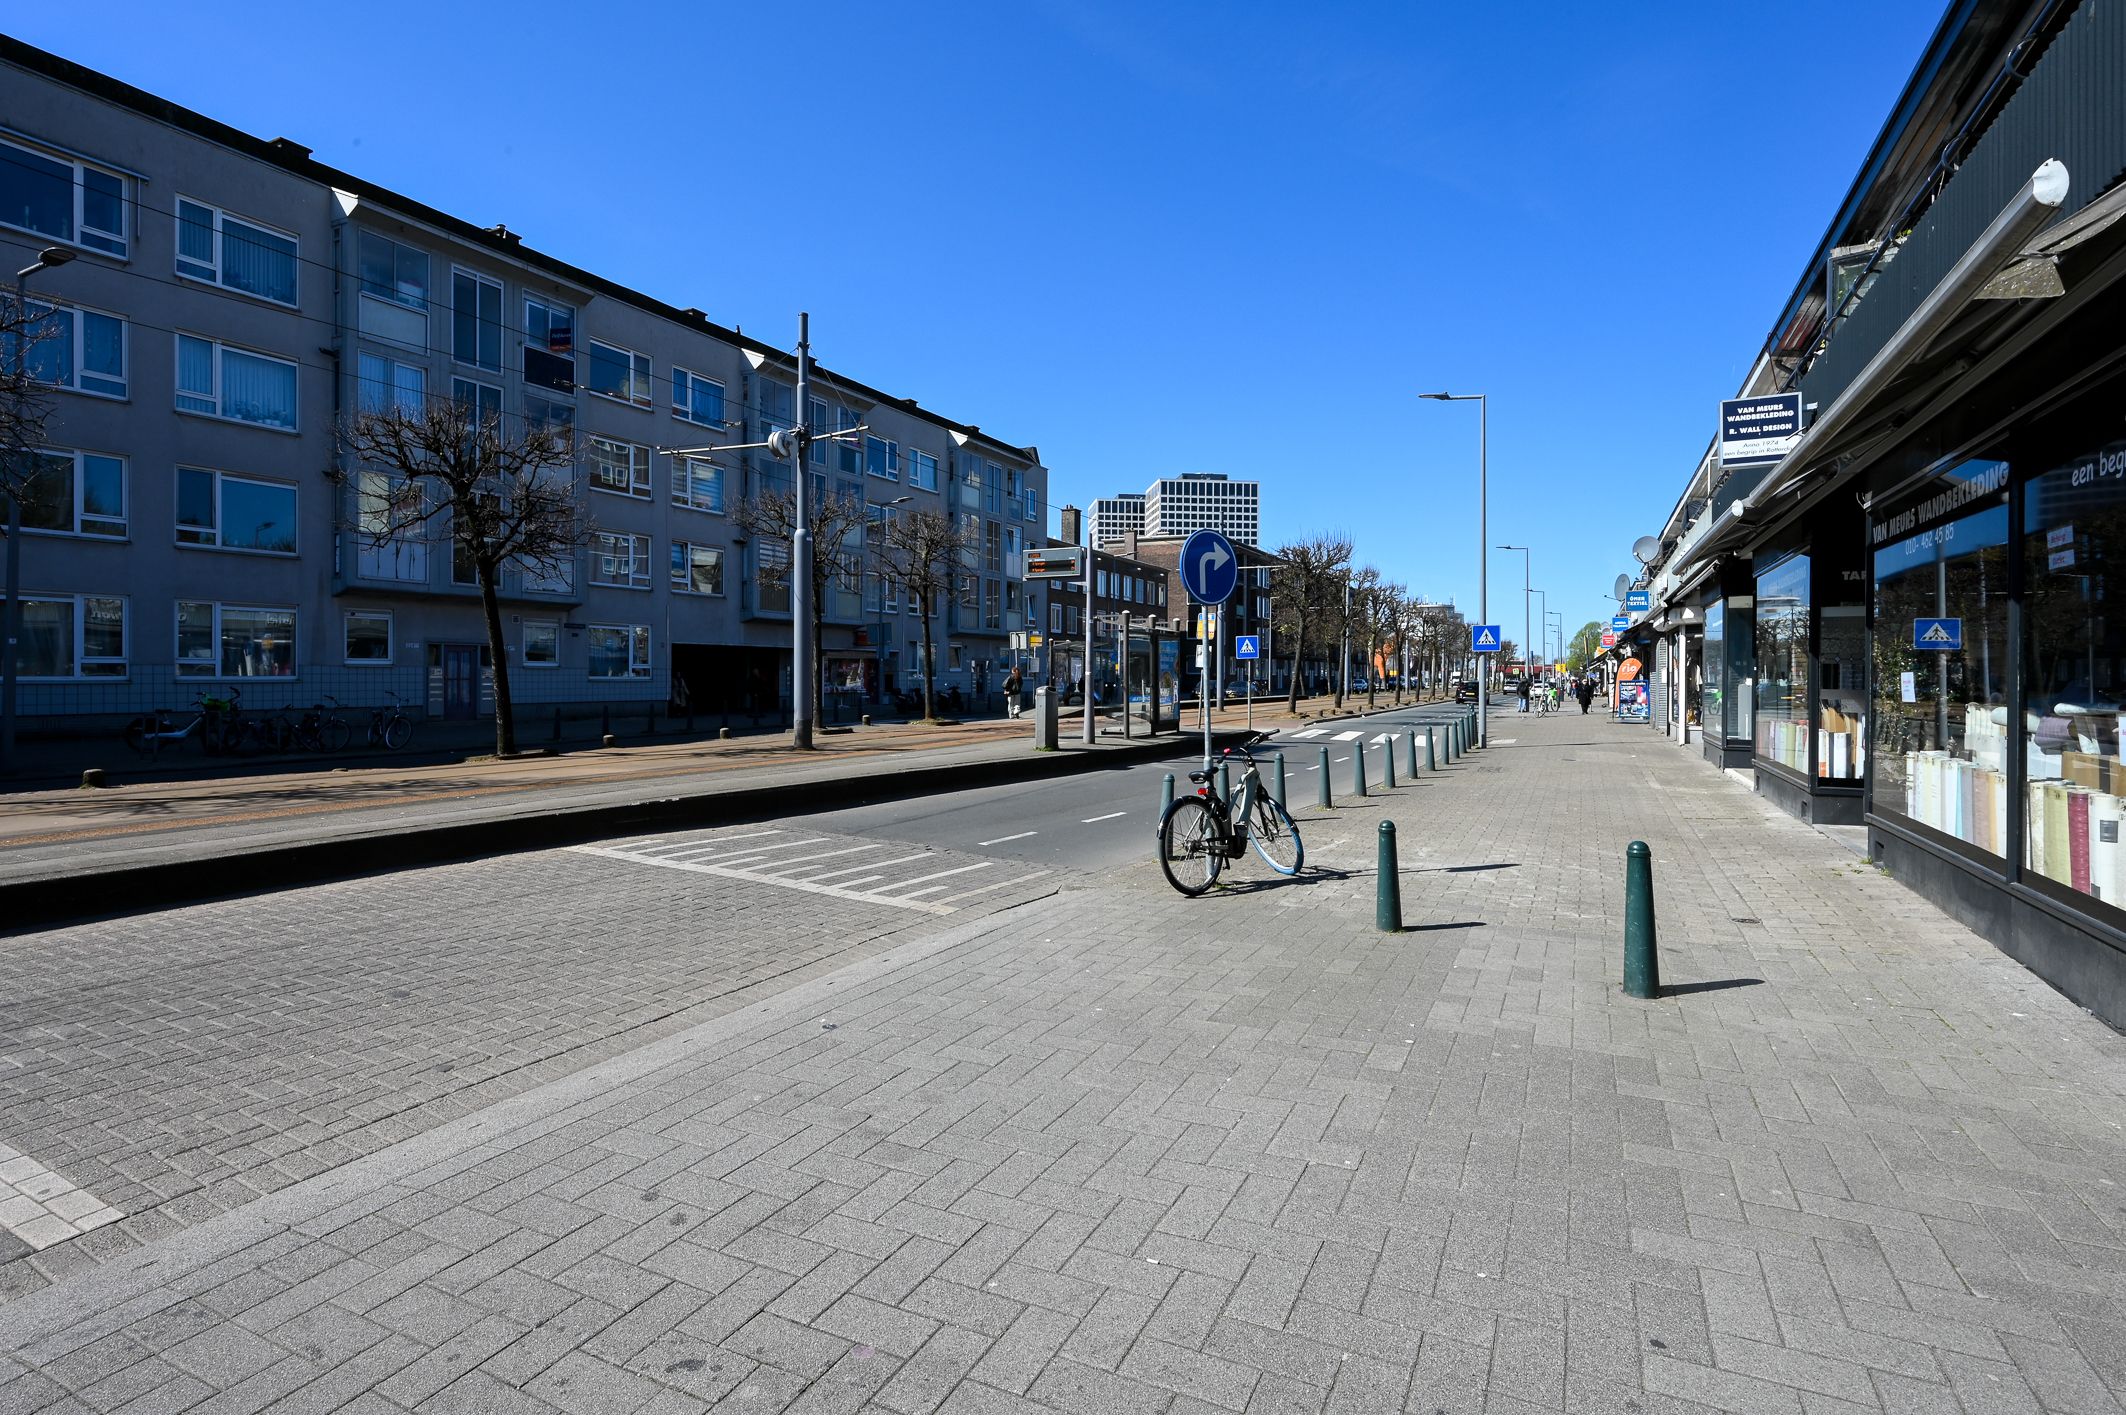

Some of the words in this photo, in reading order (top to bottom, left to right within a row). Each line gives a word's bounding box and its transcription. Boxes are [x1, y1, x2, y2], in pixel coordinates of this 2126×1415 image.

[1756, 404, 1783, 412] MEURS
[1727, 410, 1794, 422] WANDBEKLEDING
[1739, 426, 1761, 434] WALL
[1763, 423, 1792, 432] DESIGN
[1737, 448, 1757, 456] begrip
[2071, 462, 2094, 487] een
[2099, 449, 2126, 479] beg
[1873, 521, 1888, 544] VAN
[1889, 507, 1916, 538] MEURS
[1917, 460, 2010, 524] WANDBEKLEDING
[1921, 530, 1932, 549] 462
[1935, 526, 1943, 545] 45
[1945, 522, 1955, 541] 85
